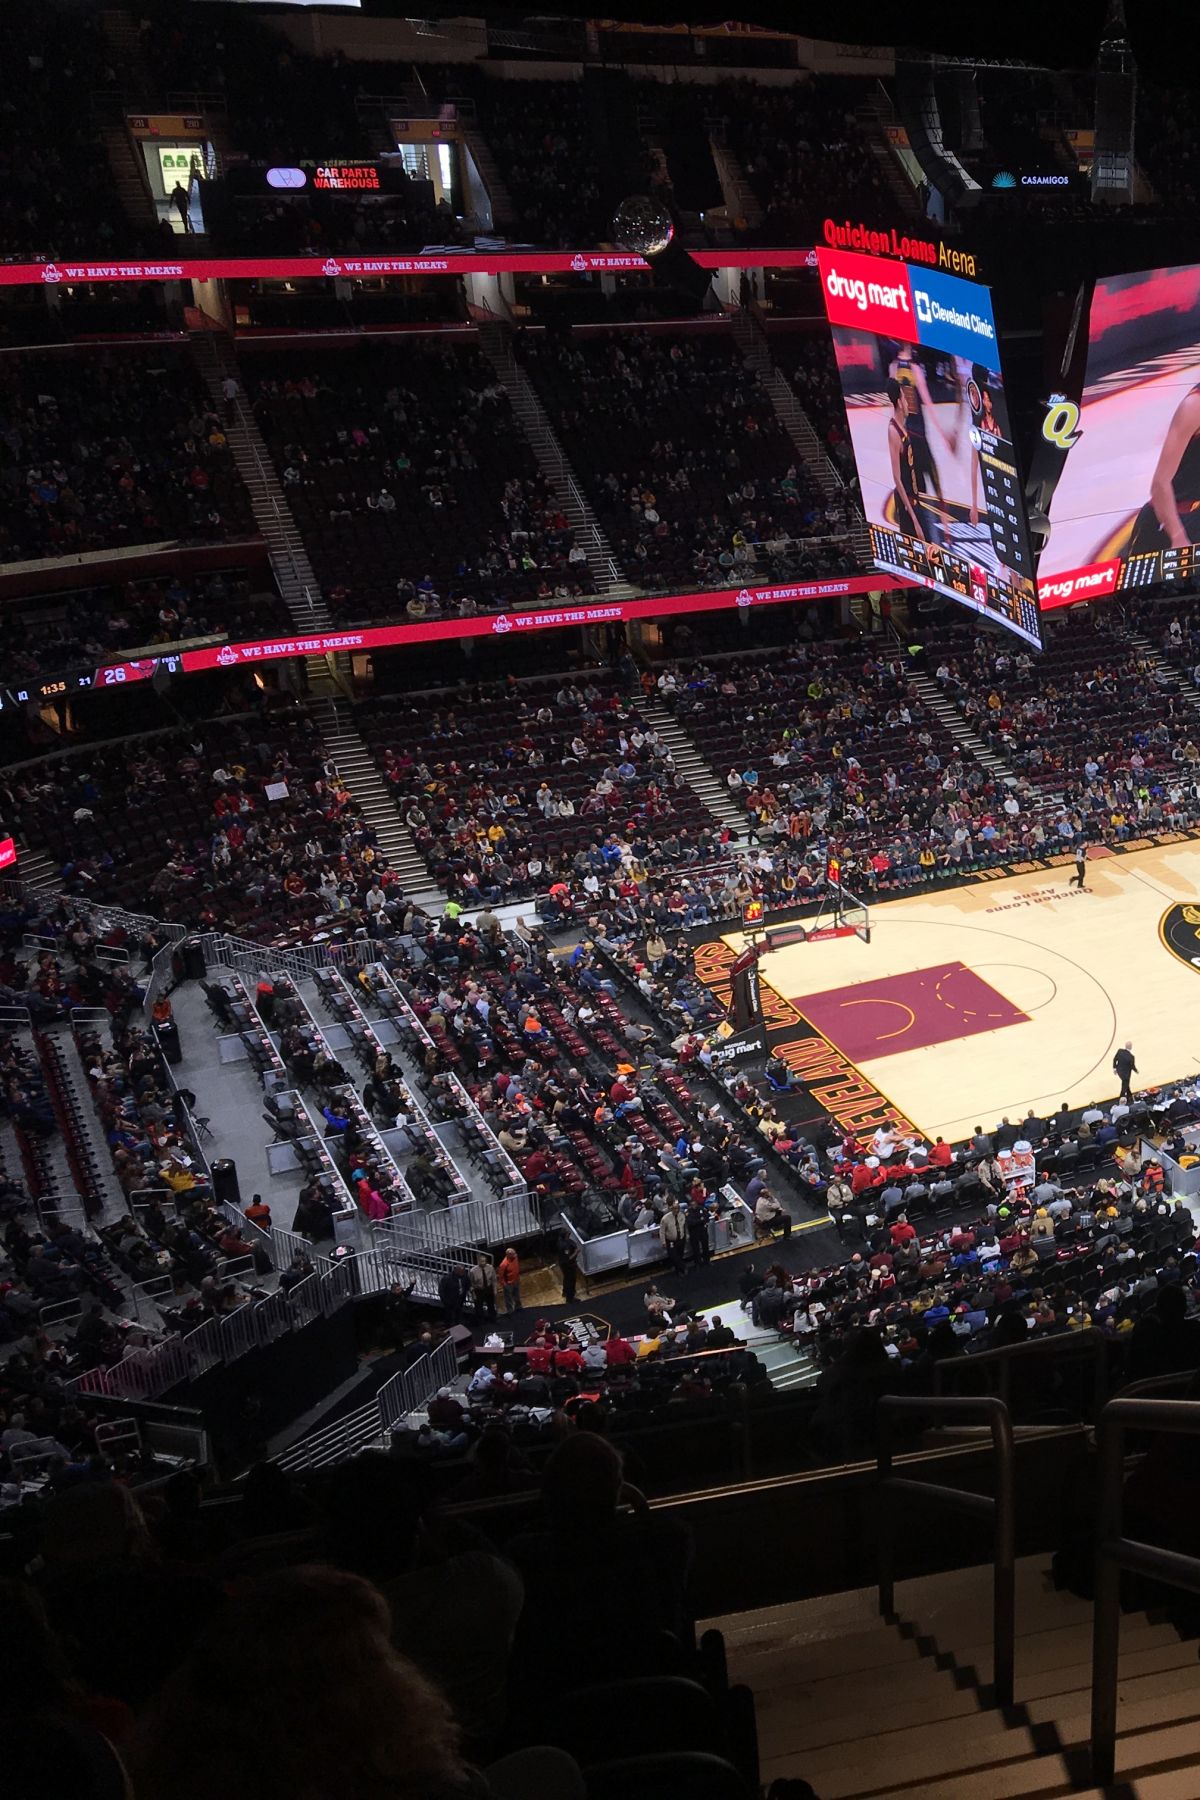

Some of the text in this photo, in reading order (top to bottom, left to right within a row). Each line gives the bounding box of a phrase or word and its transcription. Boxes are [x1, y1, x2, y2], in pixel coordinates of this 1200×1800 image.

[316, 168, 377, 178] CAR PARTS
[1021, 176, 1069, 185] CASAMIGOS
[313, 178, 381, 189] WAREHOUSE
[824, 218, 976, 277] Quicken Loans Arena
[344, 260, 448, 271] WE HAVE THE MEATS
[590, 257, 606, 266] WE
[606, 257, 631, 266] HAVE
[65, 266, 183, 277] WE HAVE THE MEATS
[826, 268, 909, 313] drug mart
[931, 301, 994, 339] Cleveland Clinic
[1048, 393, 1066, 404] The
[1042, 402, 1080, 449] Q
[933, 565, 944, 583] 14
[755, 583, 849, 601] WE HAVE THE MEATS
[952, 579, 967, 595] 1:35
[1038, 581, 1073, 600] drug
[1074, 567, 1114, 590] mart
[972, 584, 985, 603] 26
[515, 607, 622, 627] WE HAVE THE MEATS
[241, 635, 363, 658] WE HAVE THE MEATS
[161, 655, 181, 664] FOULS
[167, 661, 177, 674] 0
[17, 668, 127, 702] 1Q 1:35 21 26
[985, 887, 1094, 914] Quicken Loans
[1012, 888, 1056, 902] Arena
[737, 1039, 762, 1054] mart
